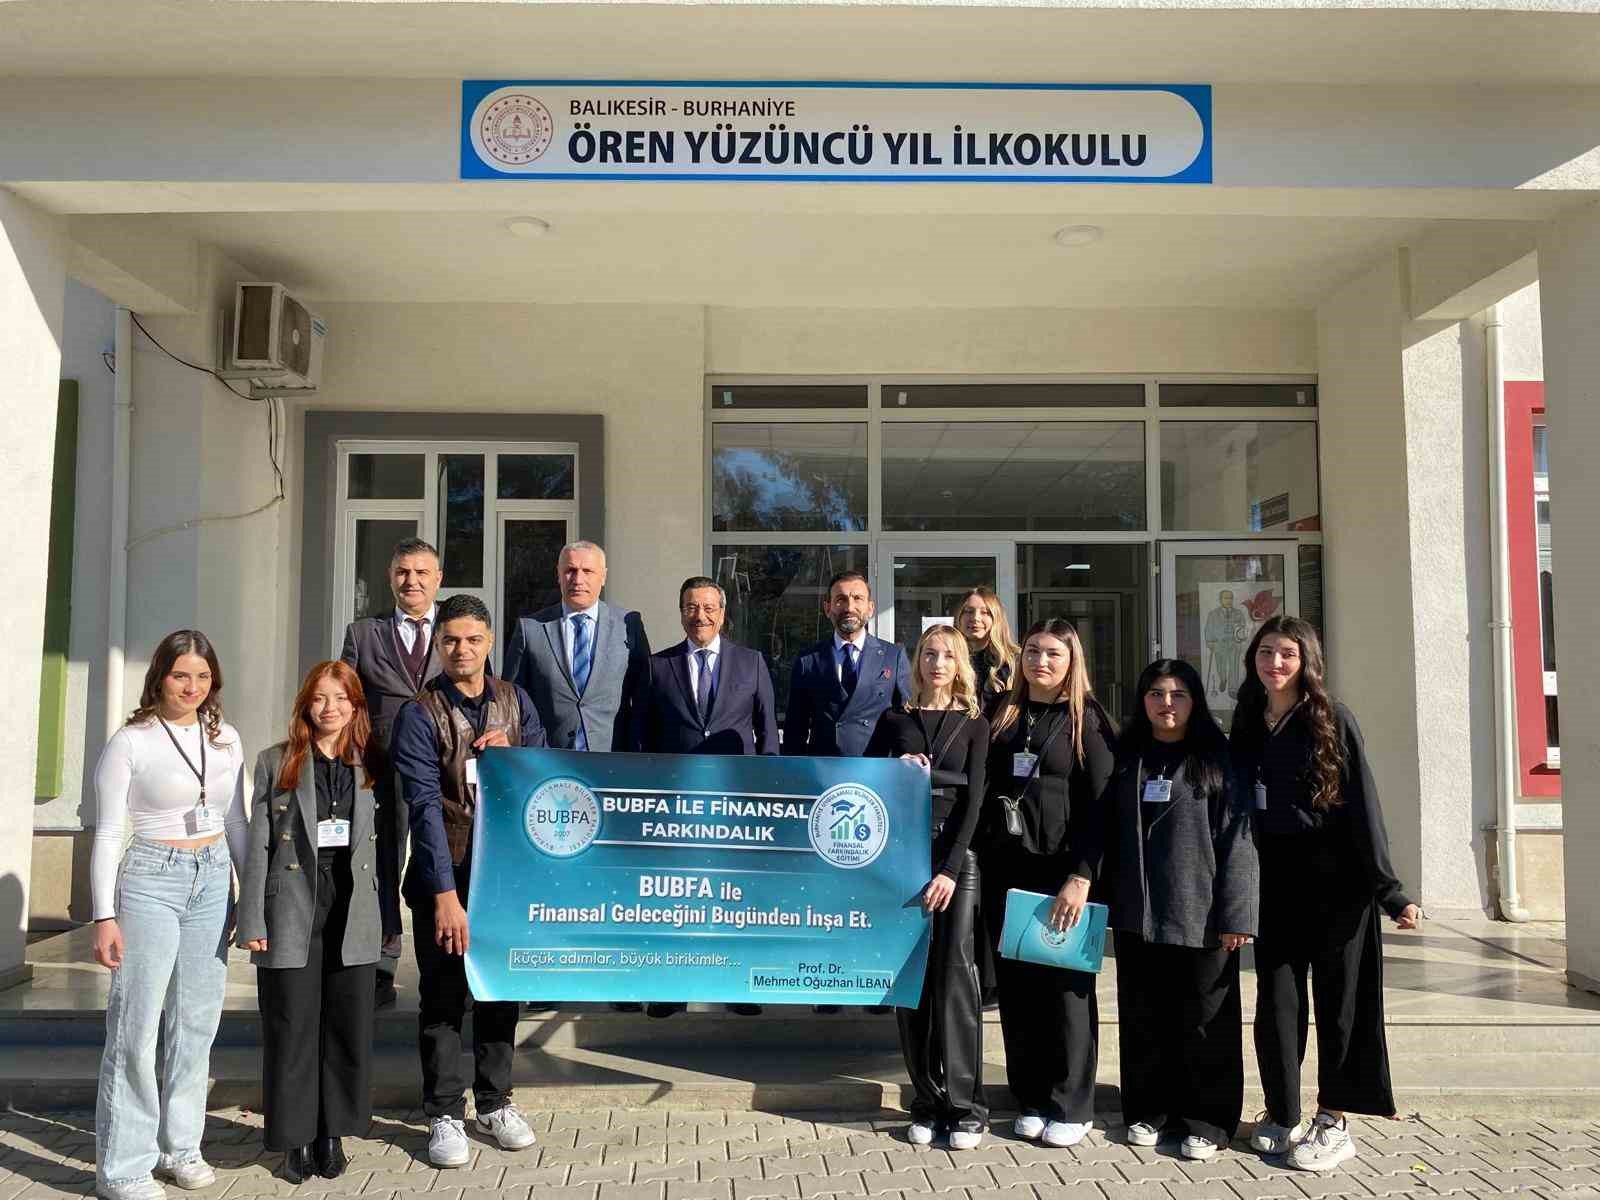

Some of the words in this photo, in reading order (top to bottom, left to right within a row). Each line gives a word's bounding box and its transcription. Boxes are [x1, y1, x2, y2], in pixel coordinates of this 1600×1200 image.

[570, 97, 666, 116] BALIKESİR
[683, 97, 796, 117] BURHANİYE
[568, 122, 675, 164] ÖREN
[684, 123, 874, 165] YÜZÜNCÜ
[882, 132, 943, 165] YIL
[952, 124, 1148, 167] İLKOKULU
[537, 809, 590, 825] BUBFA
[603, 797, 671, 815] BUBFA
[676, 795, 705, 815] İLE
[710, 796, 809, 819] FİNANSAL
[642, 822, 776, 842] FARKINDALIK
[639, 875, 714, 898] BUBFA
[720, 881, 743, 900] ile
[528, 903, 606, 923] Finansal
[612, 903, 706, 928] Geleceğini
[711, 905, 801, 929] Bugünden
[806, 905, 844, 932] İnşa
[849, 910, 873, 928] Et.
[513, 951, 555, 967] küçük
[620, 951, 662, 969] büyük
[798, 962, 826, 975] Prof.
[828, 963, 845, 975] Dr.
[753, 975, 801, 988] Mehmet
[803, 976, 854, 990] Oğuzhan
[856, 975, 892, 989] İLBAN
